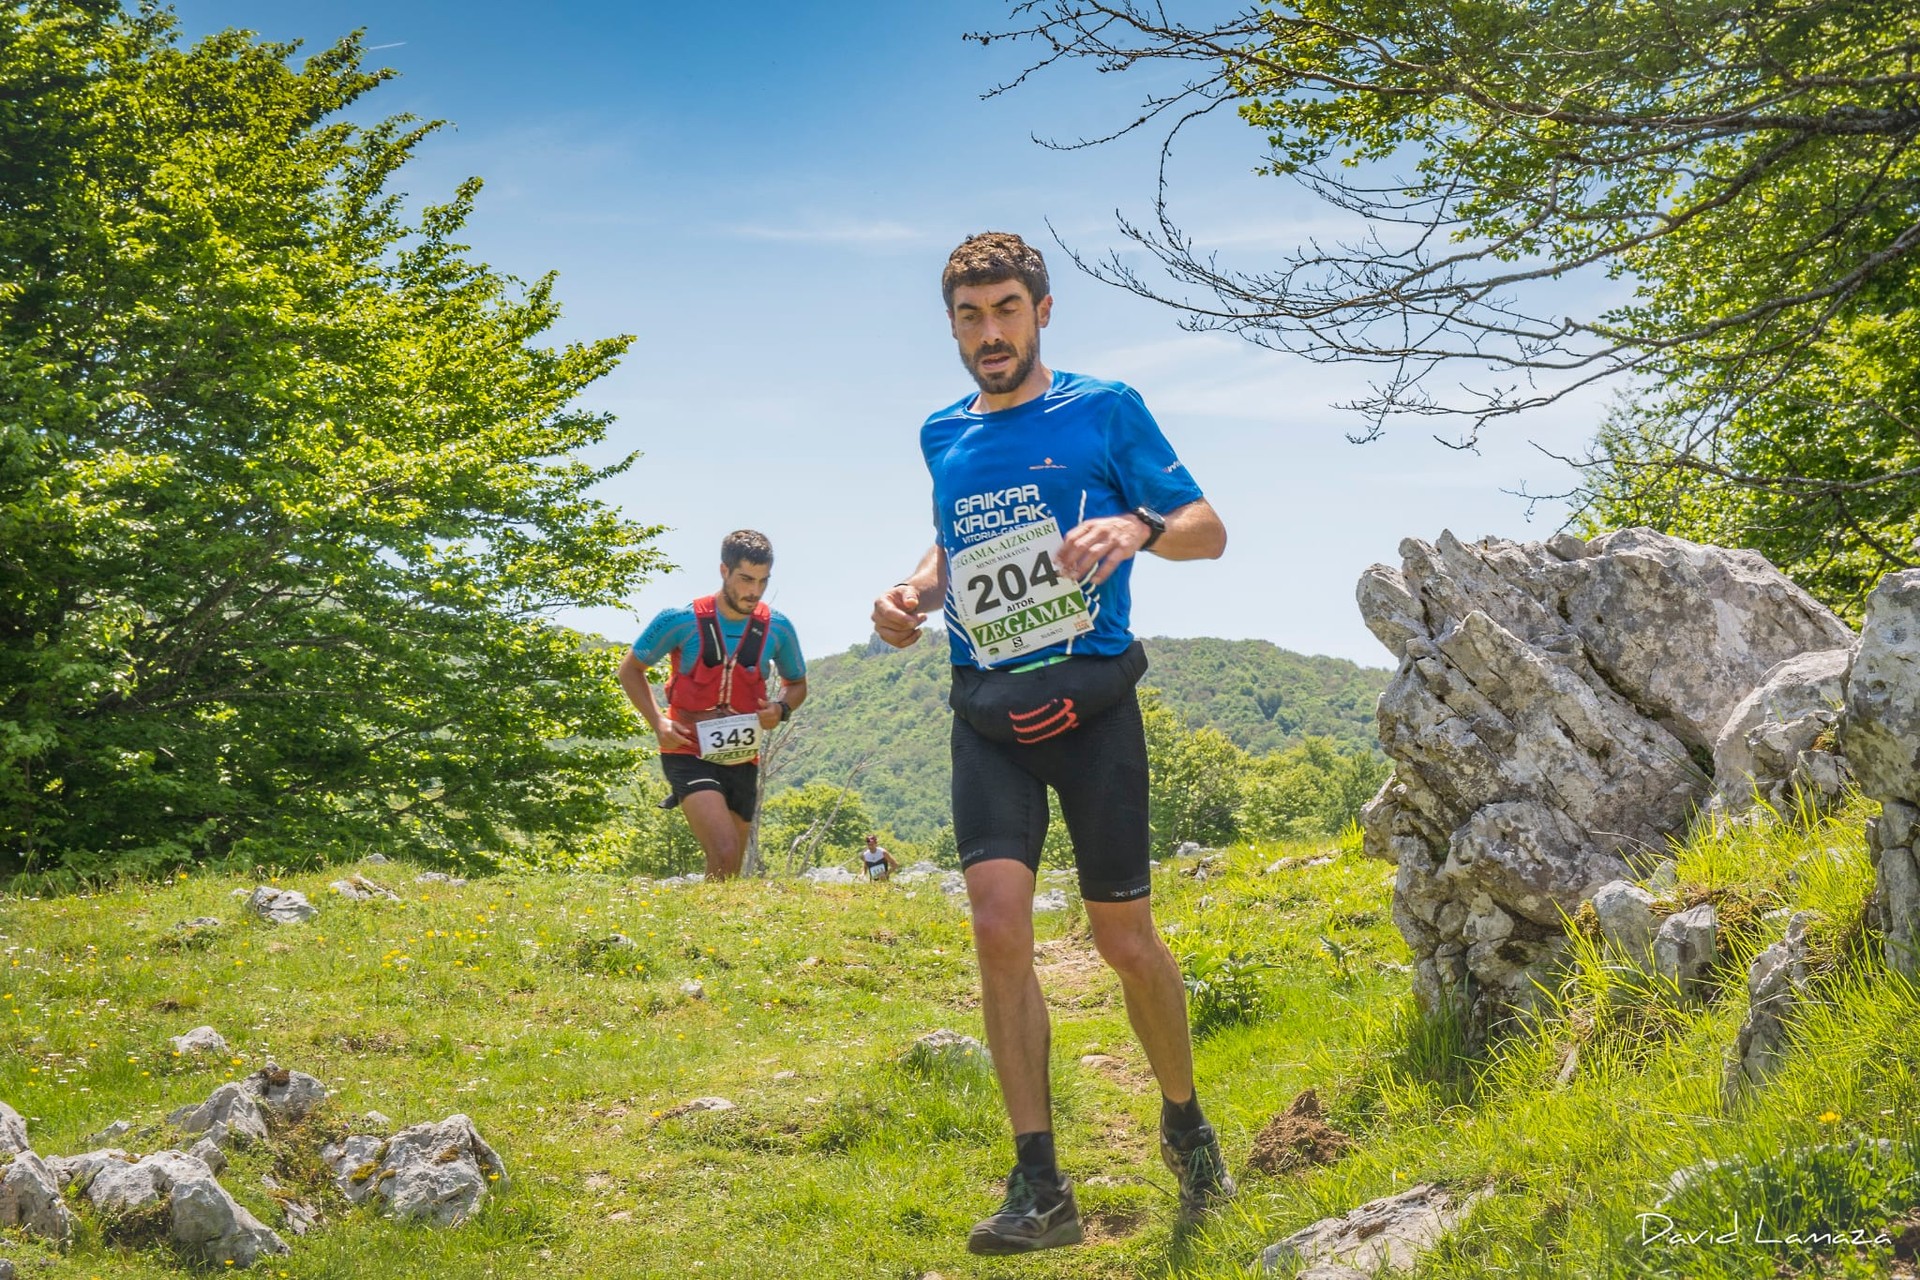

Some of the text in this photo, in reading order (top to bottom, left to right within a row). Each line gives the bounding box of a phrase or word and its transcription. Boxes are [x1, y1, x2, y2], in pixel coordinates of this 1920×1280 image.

[954, 483, 1041, 516] GAIKAR
[953, 502, 1048, 537] KIROLAK
[967, 550, 1060, 615] 204
[975, 595, 1083, 646] ZEGAMA
[1006, 597, 1036, 614] AITOR
[710, 727, 755, 749] 343
